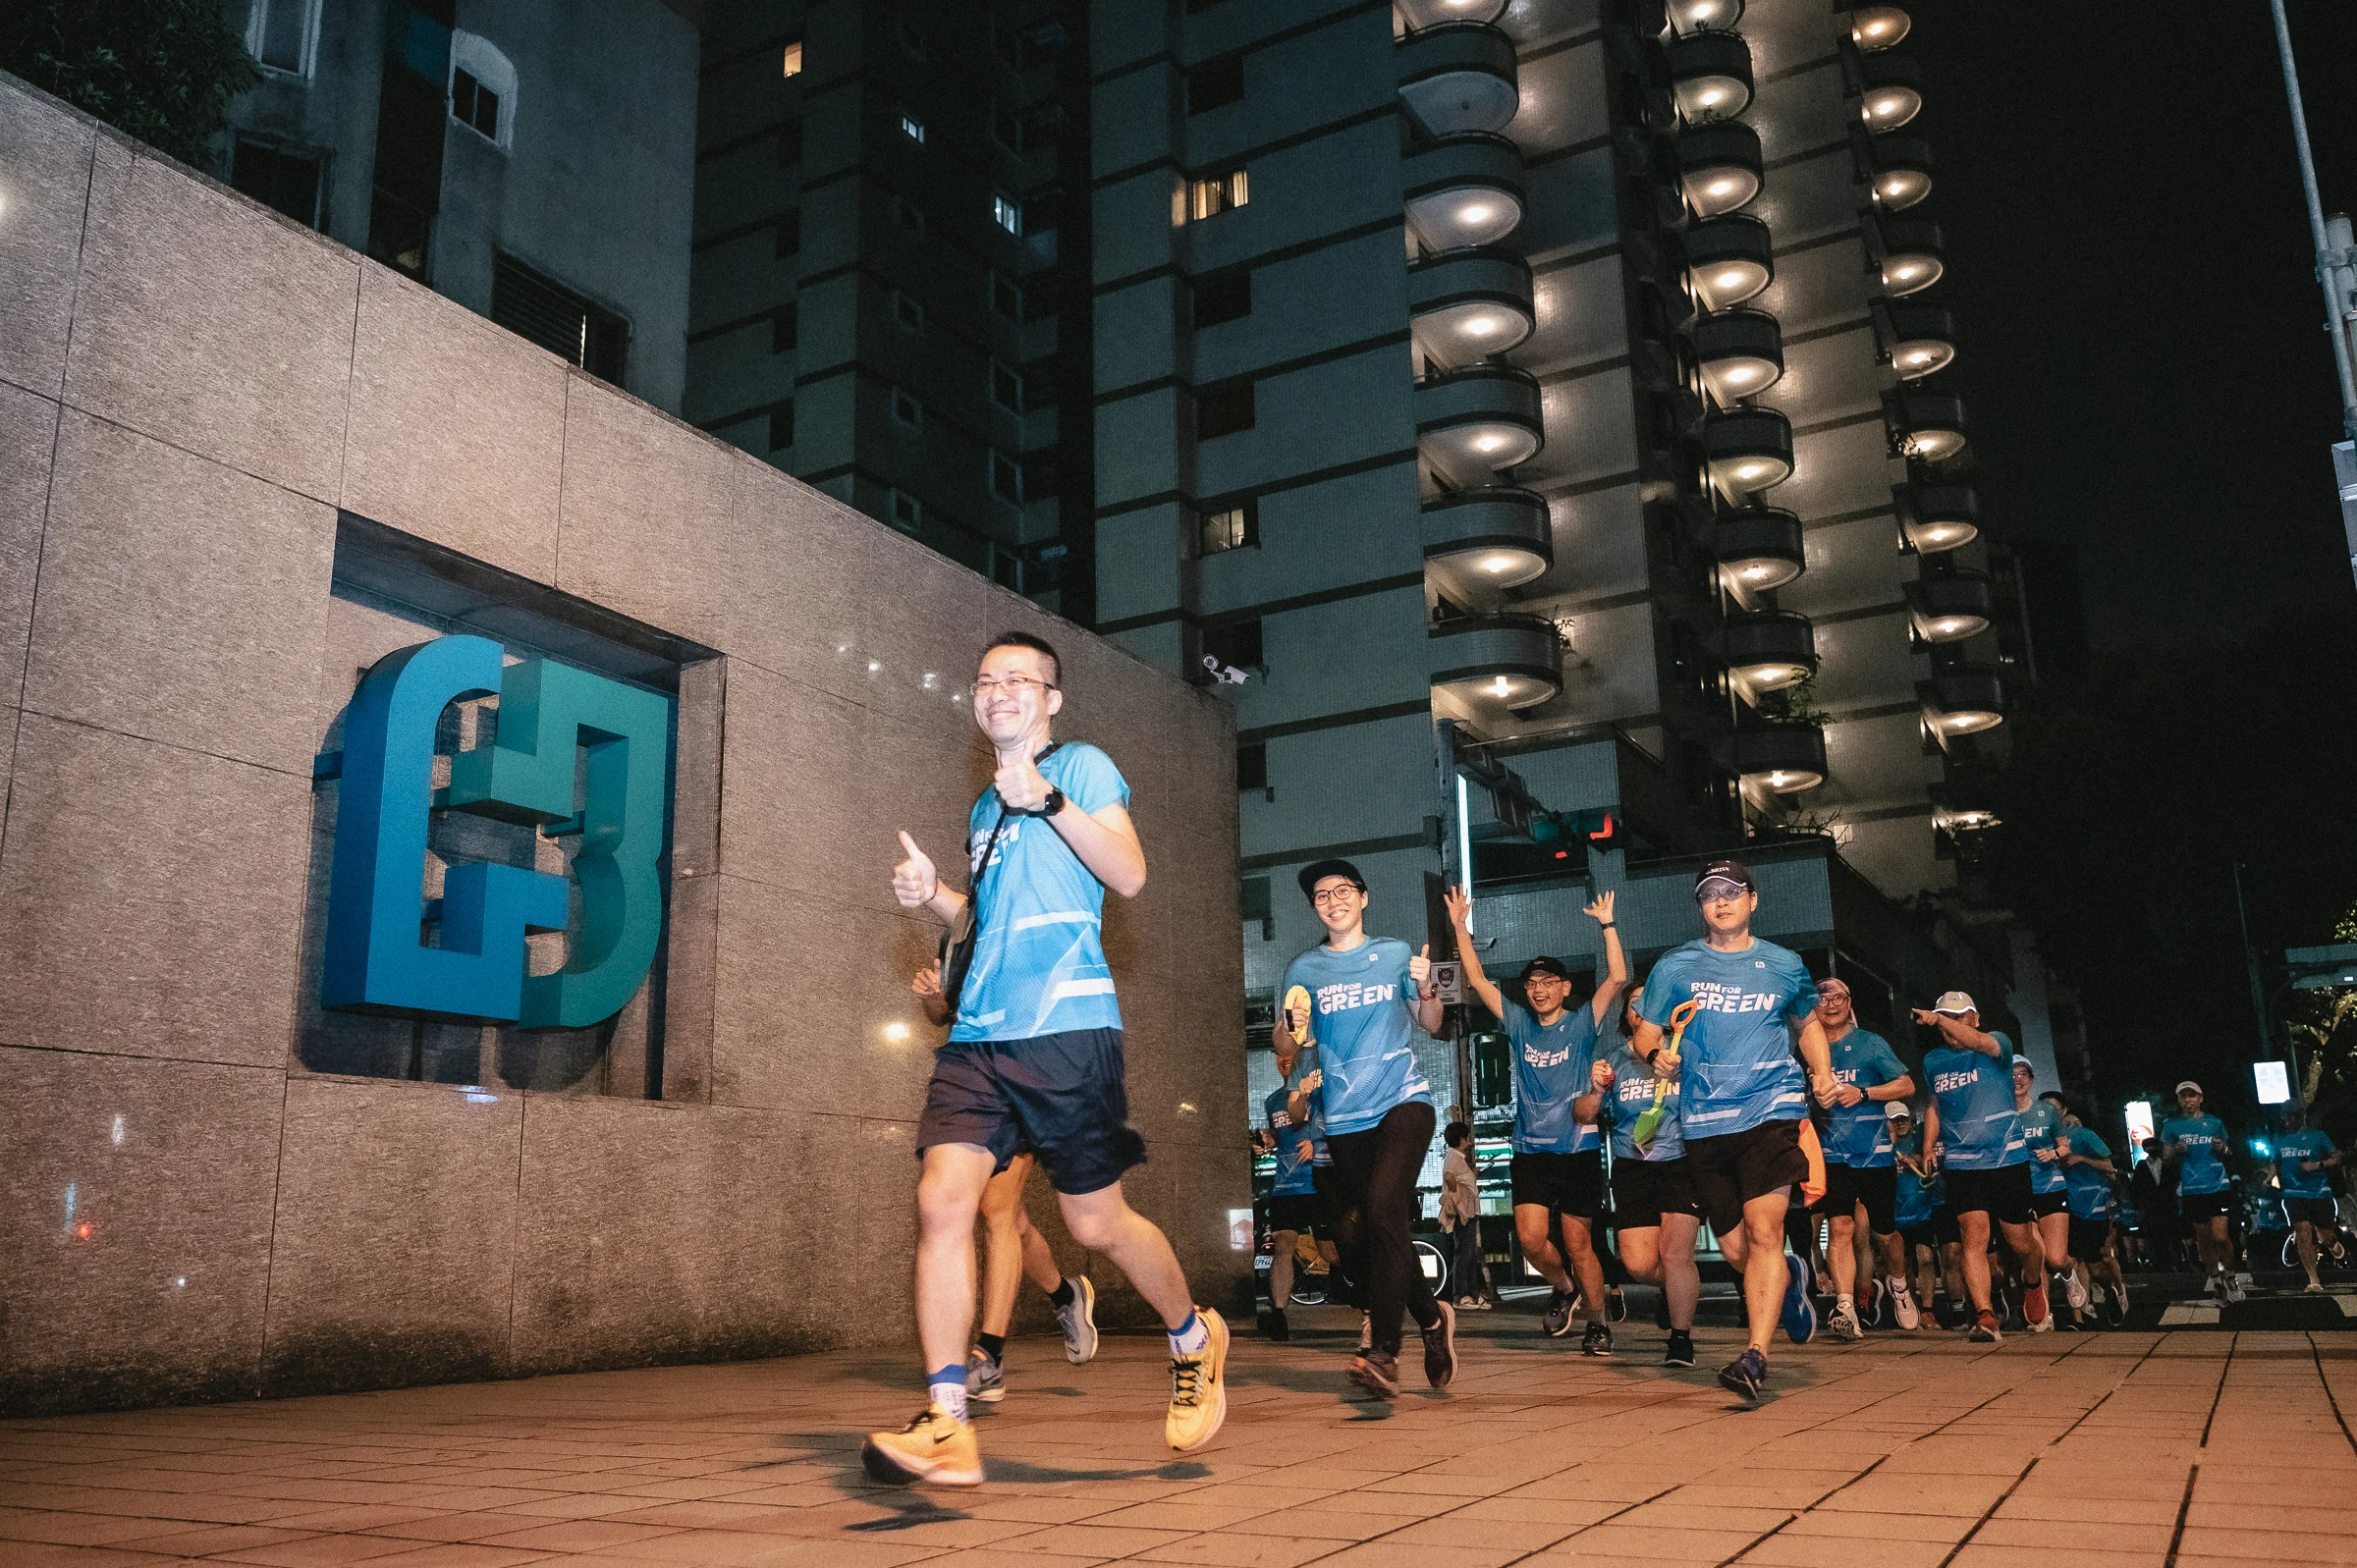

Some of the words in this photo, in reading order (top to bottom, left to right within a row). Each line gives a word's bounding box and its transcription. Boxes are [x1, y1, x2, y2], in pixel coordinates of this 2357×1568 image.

[1316, 983, 1343, 1000] RUN
[1343, 982, 1362, 992] FOR
[1690, 982, 1722, 994] RUN
[1722, 986, 1742, 995] FOR
[1319, 984, 1394, 1015] GREEN
[1693, 992, 1777, 1013] GREEN
[1618, 1077, 1640, 1090] RUN
[1934, 1068, 1979, 1094] GREEN
